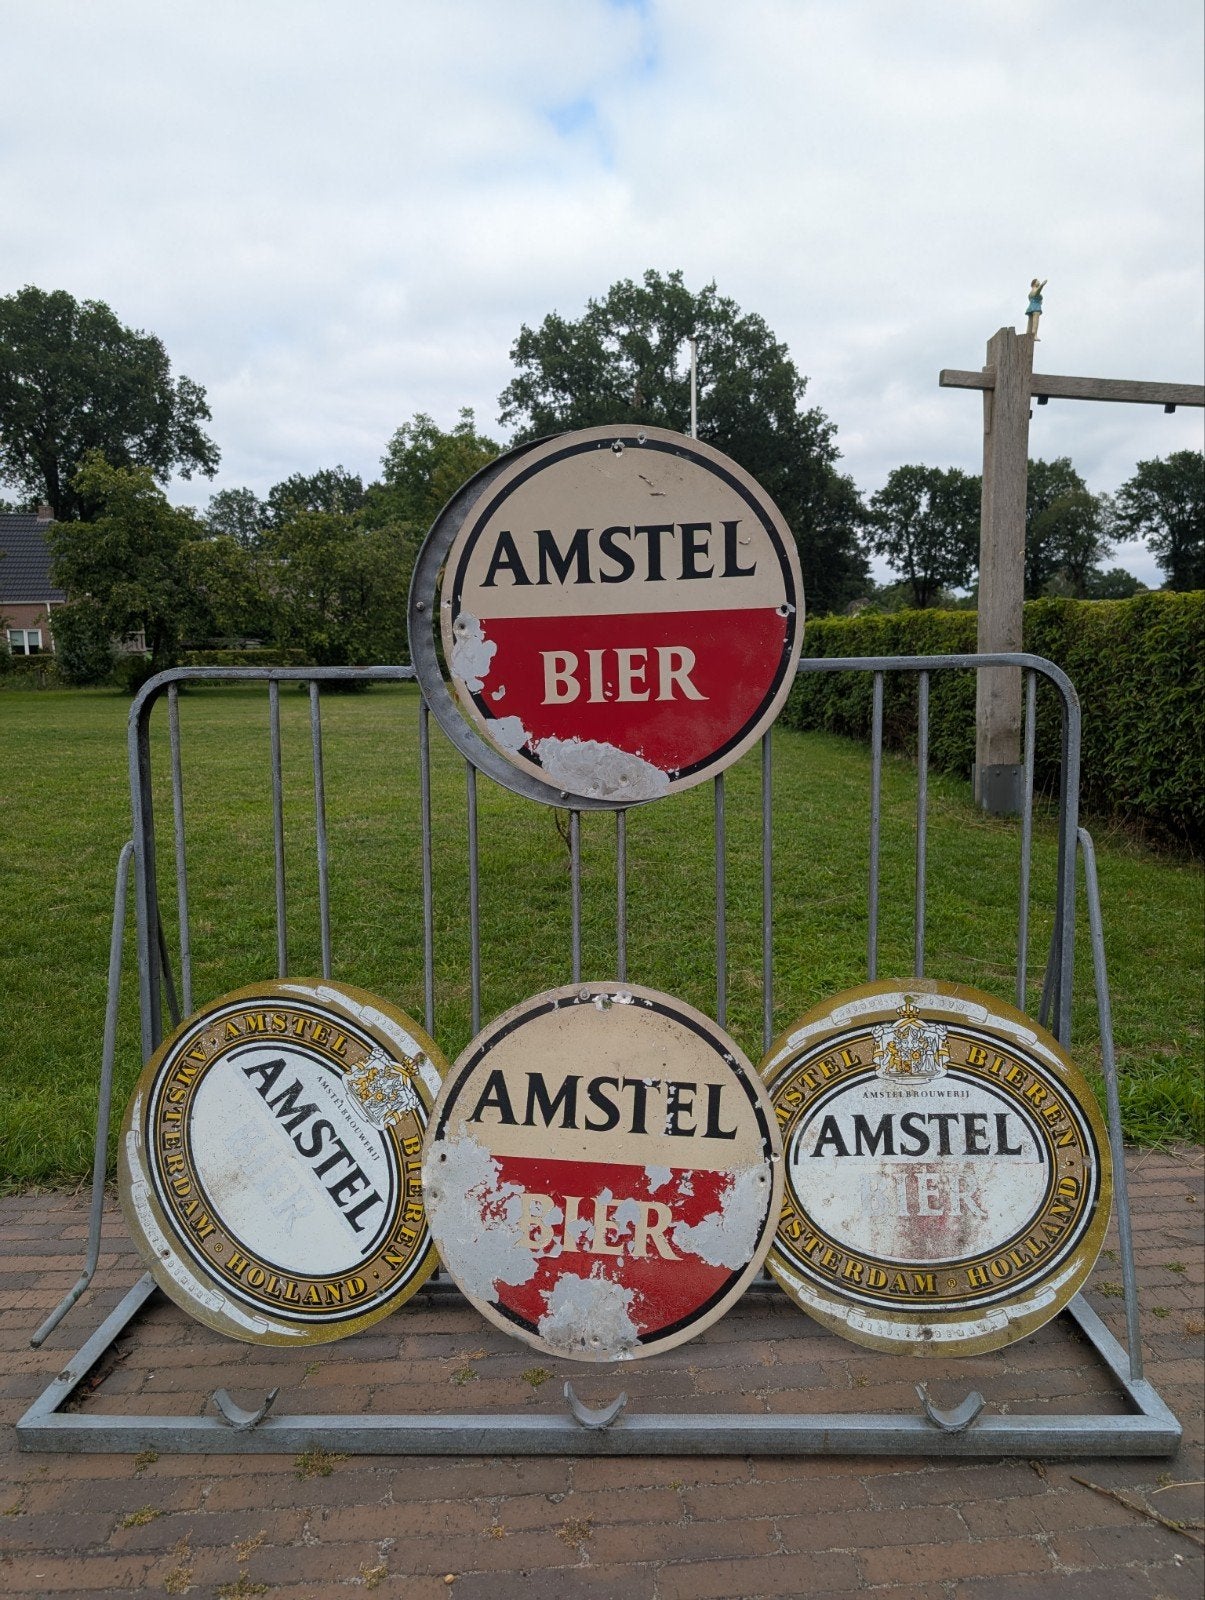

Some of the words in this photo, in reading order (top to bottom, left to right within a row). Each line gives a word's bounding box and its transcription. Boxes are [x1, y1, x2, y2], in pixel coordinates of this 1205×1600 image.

[479, 520, 757, 587] AMSTEL
[539, 645, 710, 705] BIER
[317, 1075, 380, 1161] AMSTELBROUWERIJ
[466, 1069, 738, 1140] AMSTEL
[774, 1049, 862, 1132] MSTEL
[965, 1046, 1076, 1149] BIEREN
[862, 1090, 970, 1099] AMSTELBROUWERIJ
[223, 1012, 348, 1058] AMSTEL
[381, 1134, 425, 1270] BIEREN
[241, 1057, 385, 1233] AMSTEL
[810, 1112, 1022, 1156] AMSTEL
[161, 1041, 217, 1243] AMSTERDAM
[225, 1250, 367, 1306] HOLLAND
[512, 1193, 684, 1261] BIER
[778, 1193, 938, 1296] MSTERDAM
[965, 1175, 1080, 1289] HOLLAND
